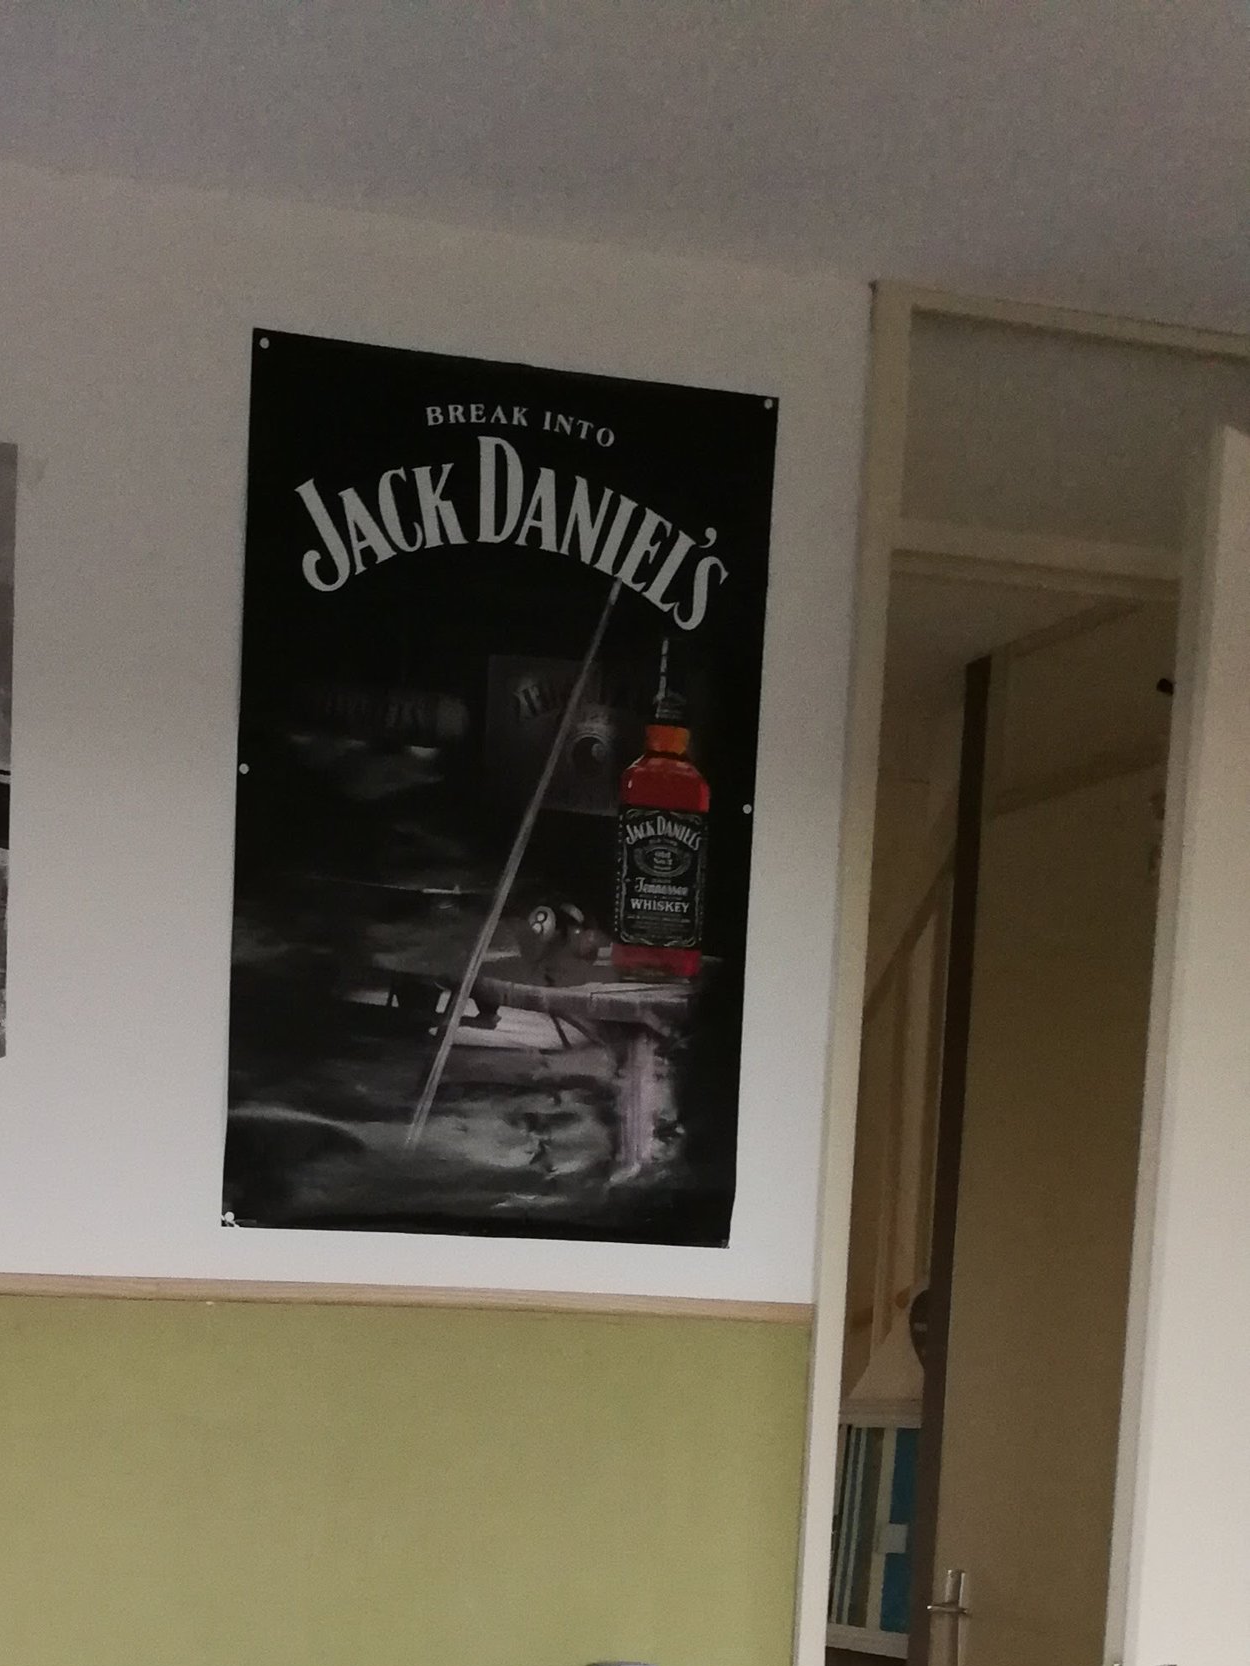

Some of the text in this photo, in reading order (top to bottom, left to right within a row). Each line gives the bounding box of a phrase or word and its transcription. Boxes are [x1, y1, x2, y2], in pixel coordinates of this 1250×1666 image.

[425, 403, 616, 447] BREAK INTO
[294, 435, 730, 631] JACK DANIEL'S
[626, 820, 656, 845] JACK
[630, 897, 690, 913] WHISKEY
